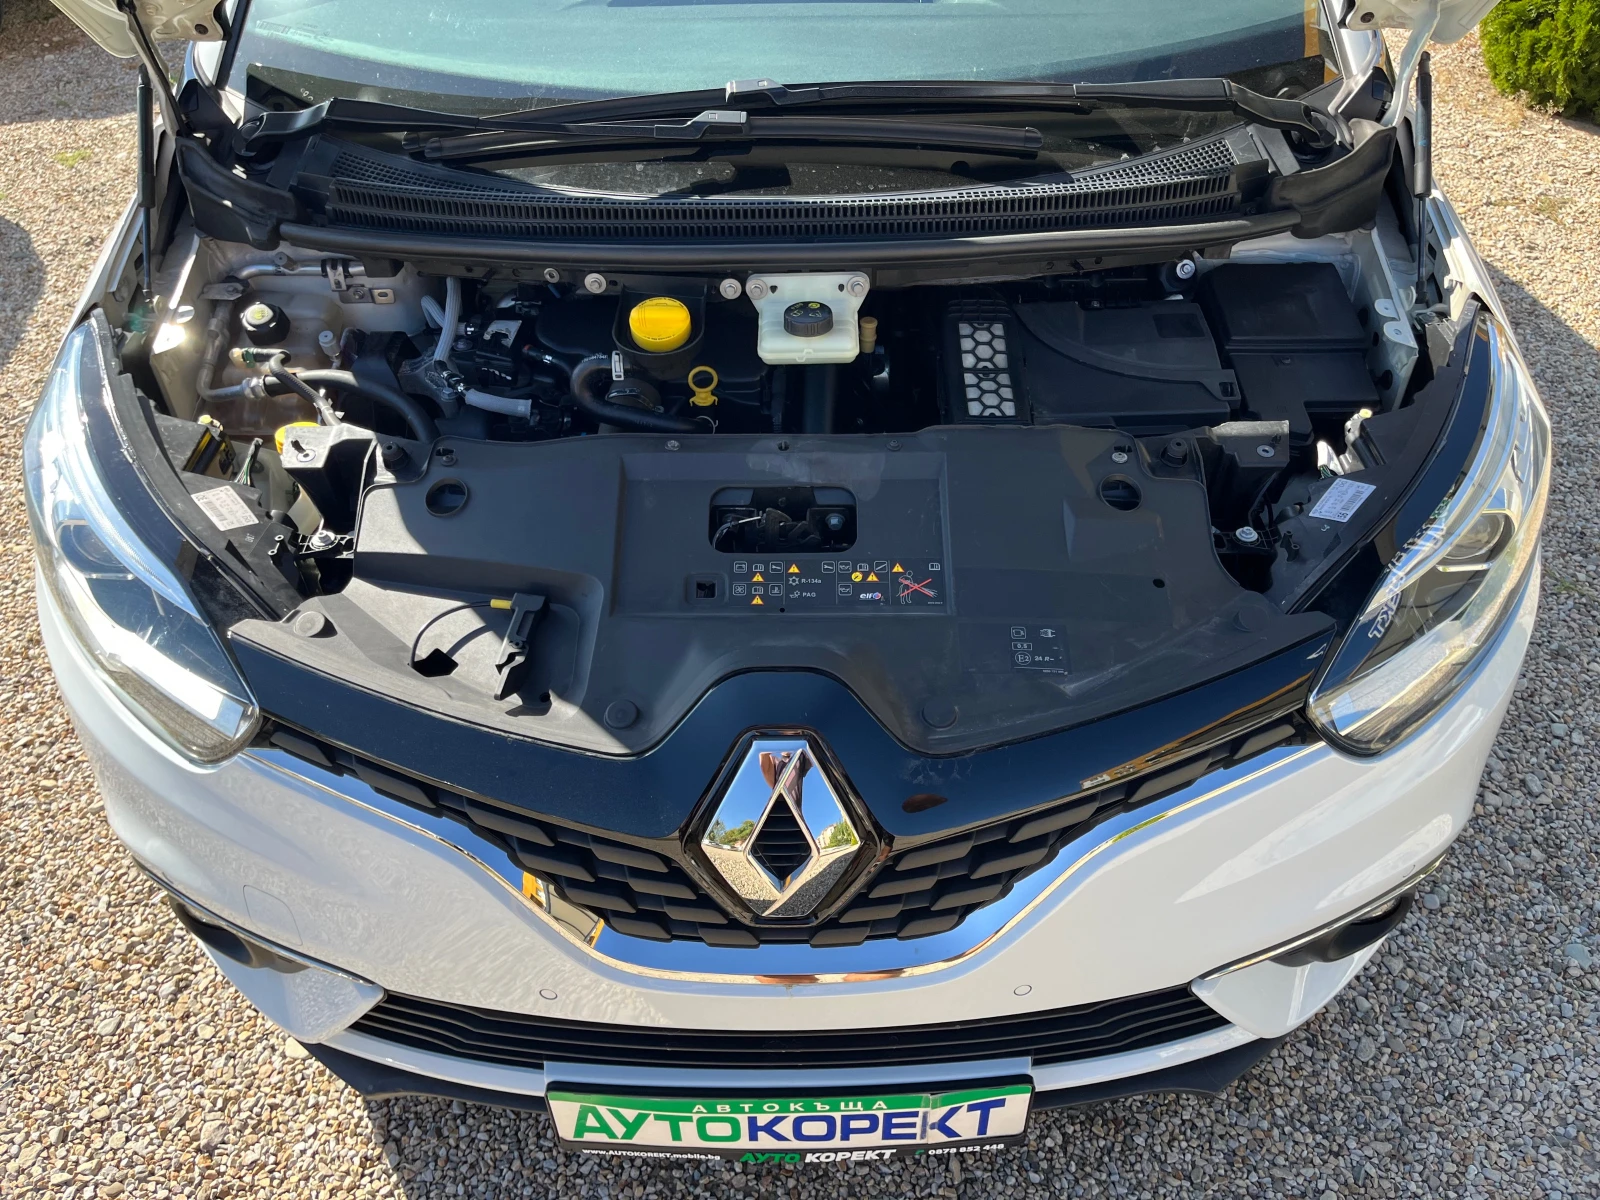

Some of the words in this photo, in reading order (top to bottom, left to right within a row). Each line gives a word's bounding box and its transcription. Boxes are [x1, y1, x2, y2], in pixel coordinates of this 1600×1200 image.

[1018, 654, 1030, 662] E2
[691, 1100, 888, 1113] АВТОКЪЩА
[573, 1098, 1007, 1142] АУТОКОРЕКТ
[928, 1147, 957, 1155] 0878
[959, 1145, 981, 1153] 852
[982, 1143, 1005, 1151] 448
[739, 1151, 801, 1164] АУТО
[804, 1149, 897, 1163] КОРЕКТ
